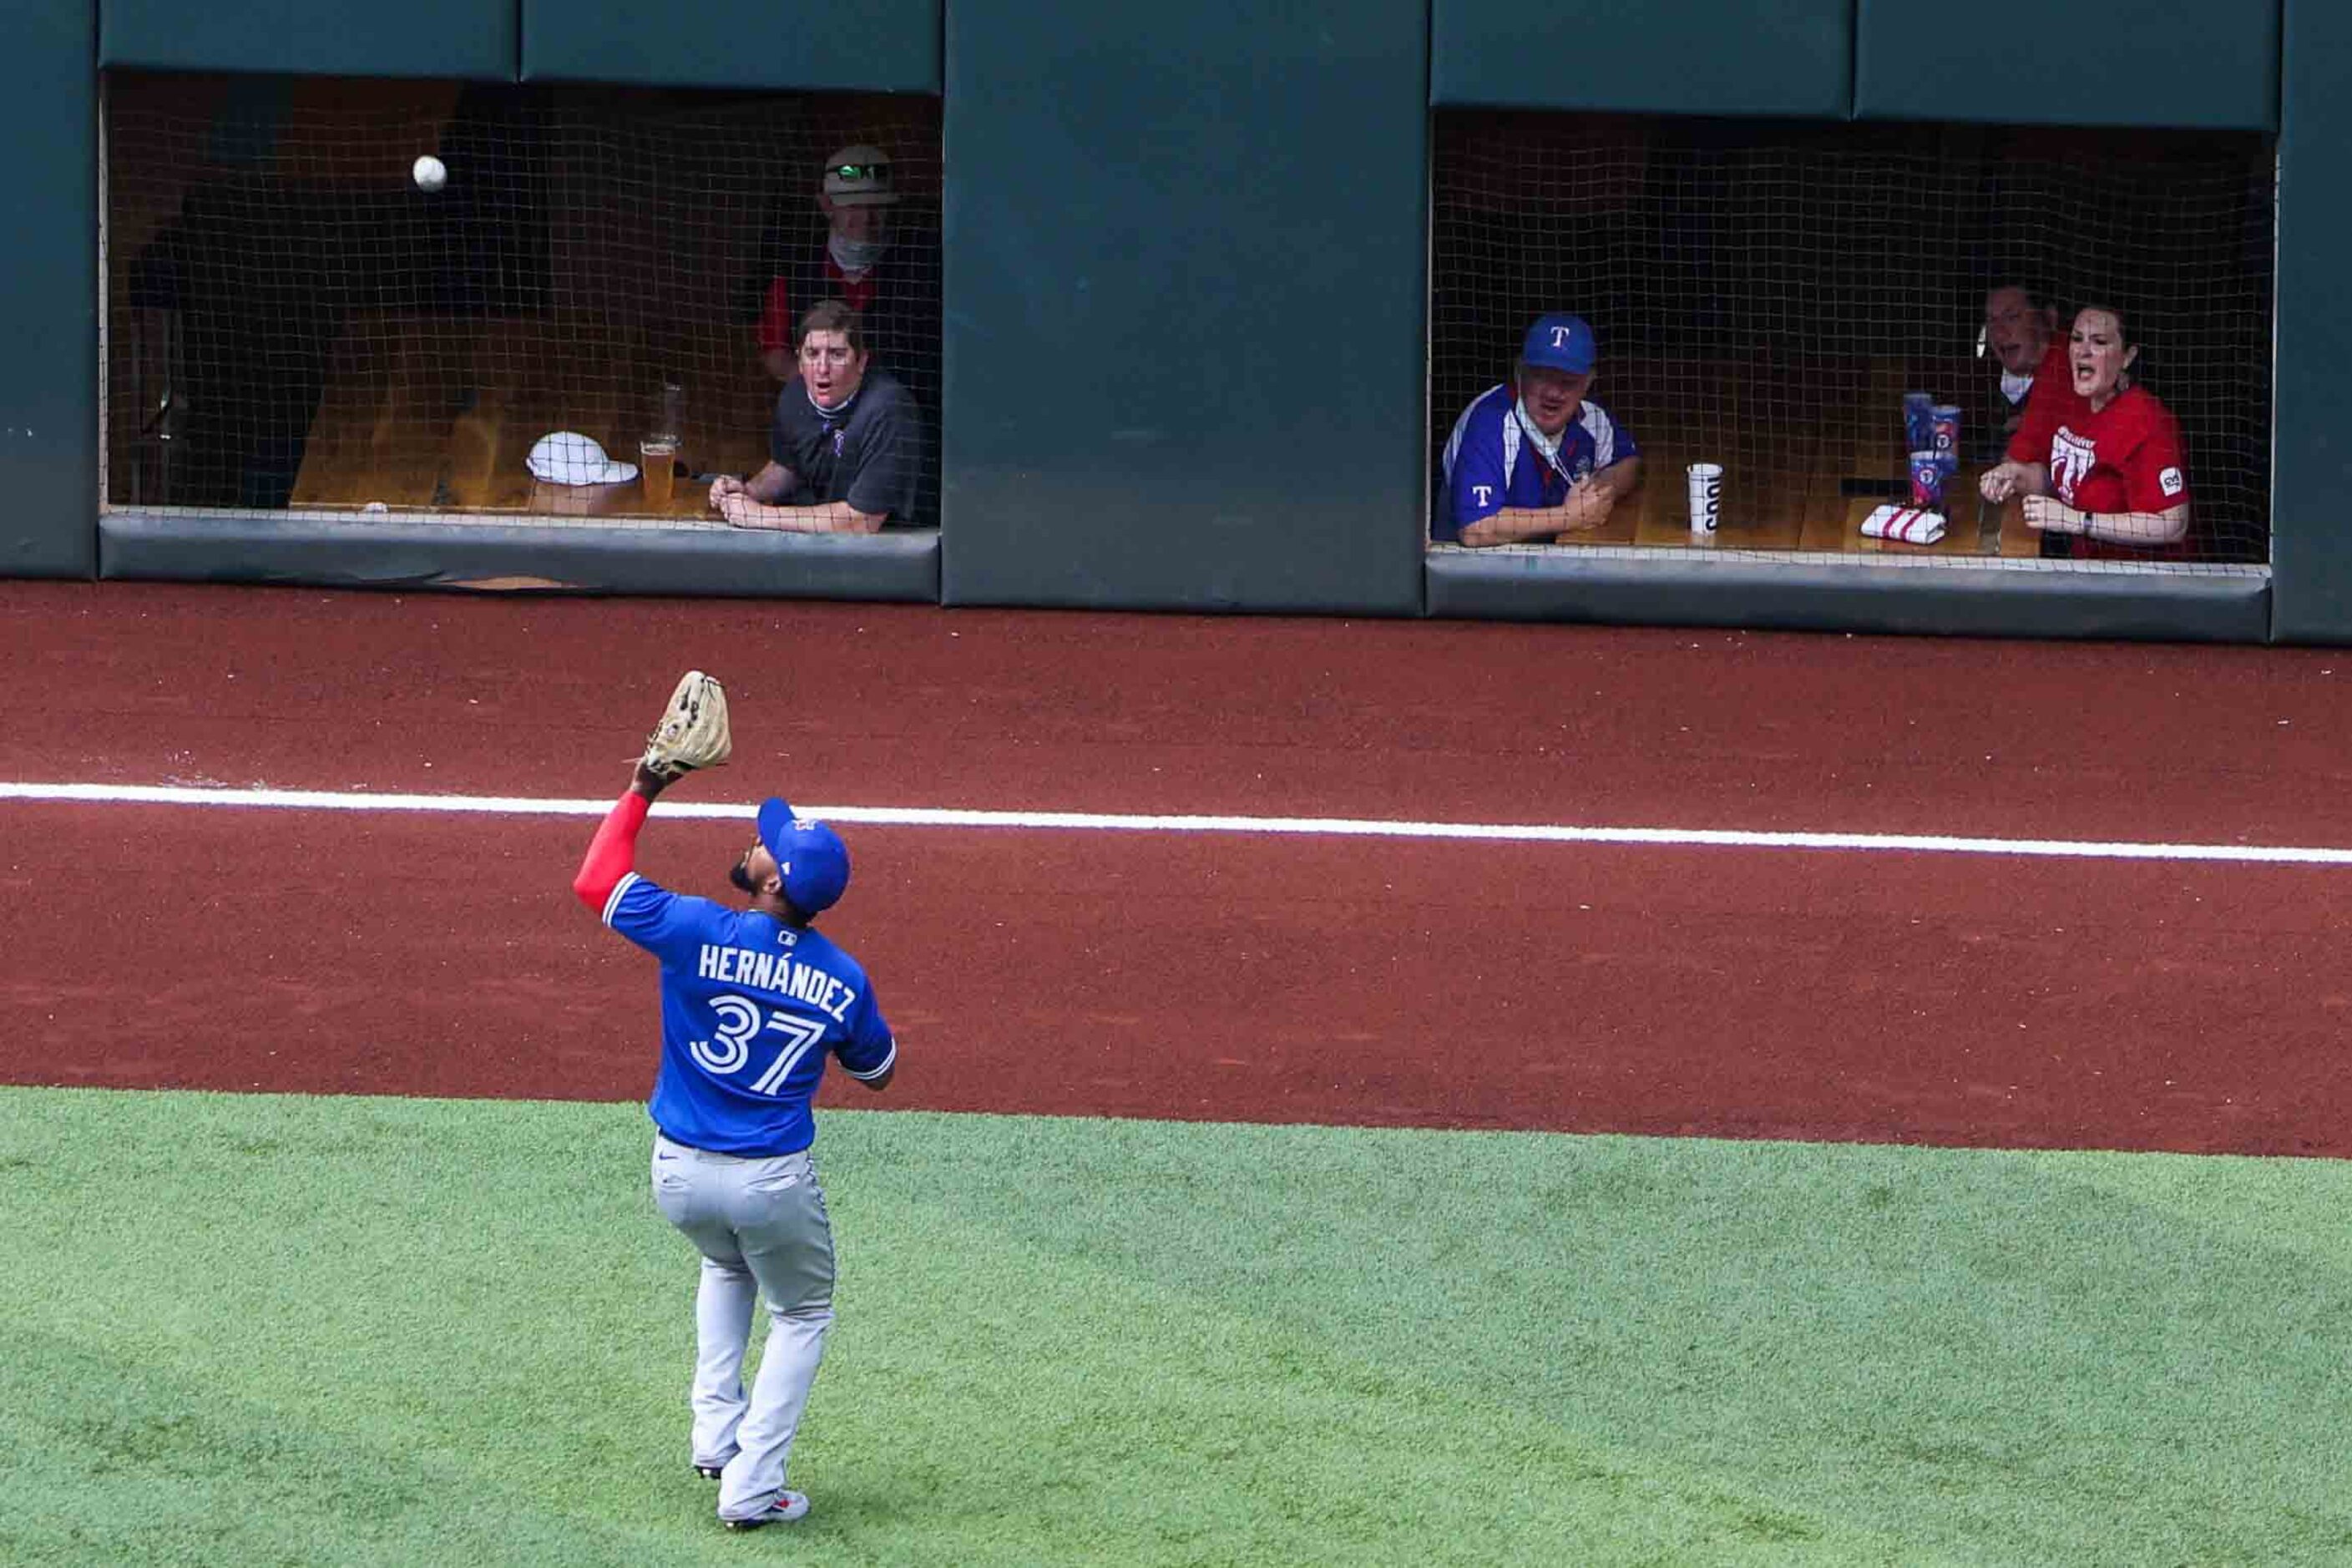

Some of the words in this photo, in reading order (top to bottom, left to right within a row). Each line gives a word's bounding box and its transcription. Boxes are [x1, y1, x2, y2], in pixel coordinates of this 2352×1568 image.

[1550, 326, 1570, 347] T
[1472, 486, 1492, 507] T
[699, 944, 856, 1023] HERNÁNDEZ
[690, 995, 827, 1095] 37
